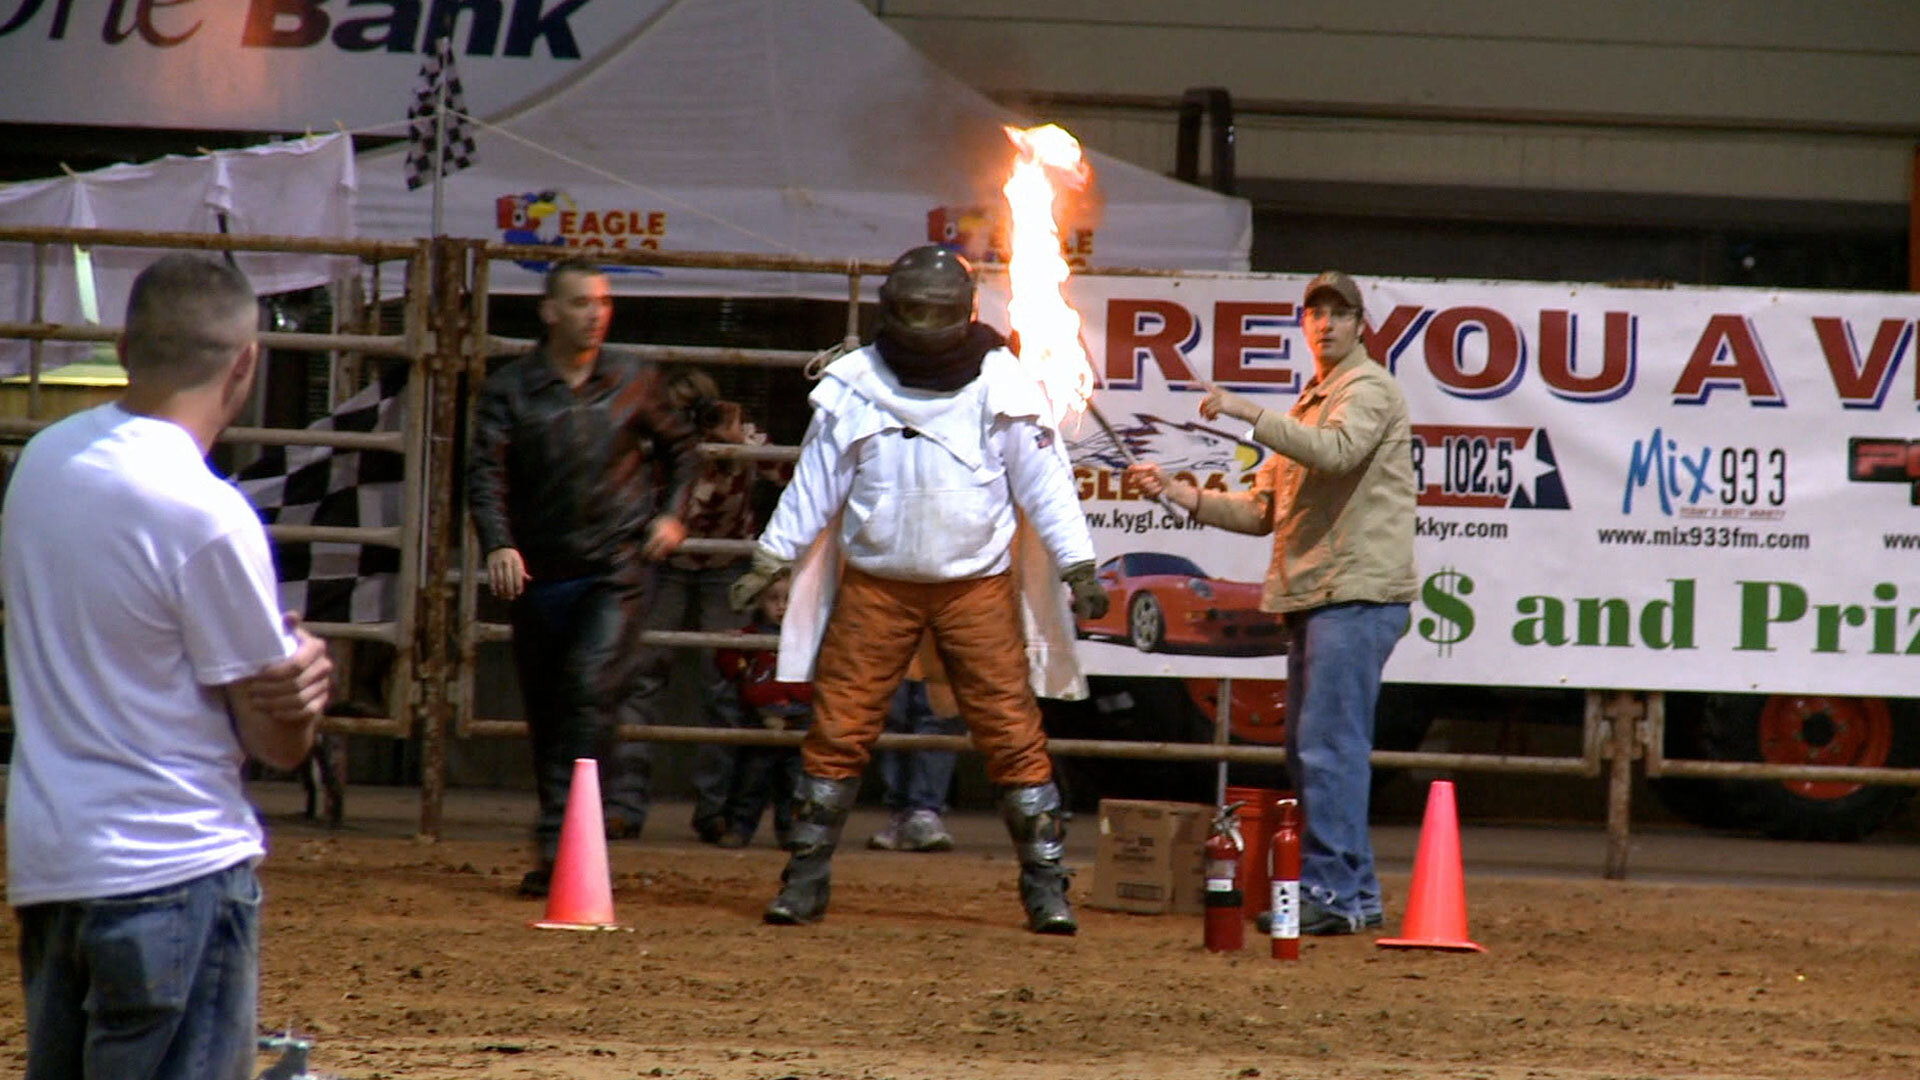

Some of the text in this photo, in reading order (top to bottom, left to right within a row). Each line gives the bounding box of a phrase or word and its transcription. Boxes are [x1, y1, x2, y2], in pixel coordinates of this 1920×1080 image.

[0, 0, 590, 59] ne Bank
[559, 210, 667, 236] EAGLE
[1093, 297, 1303, 394] RE
[1672, 313, 1788, 408] A
[1812, 316, 1920, 411] V
[1444, 437, 1513, 495] 102.5
[1622, 427, 1714, 515] Mix
[1415, 516, 1509, 541] kkyr.com
[1598, 526, 1810, 550] www.mix933fm.com
[1511, 578, 1698, 651] and
